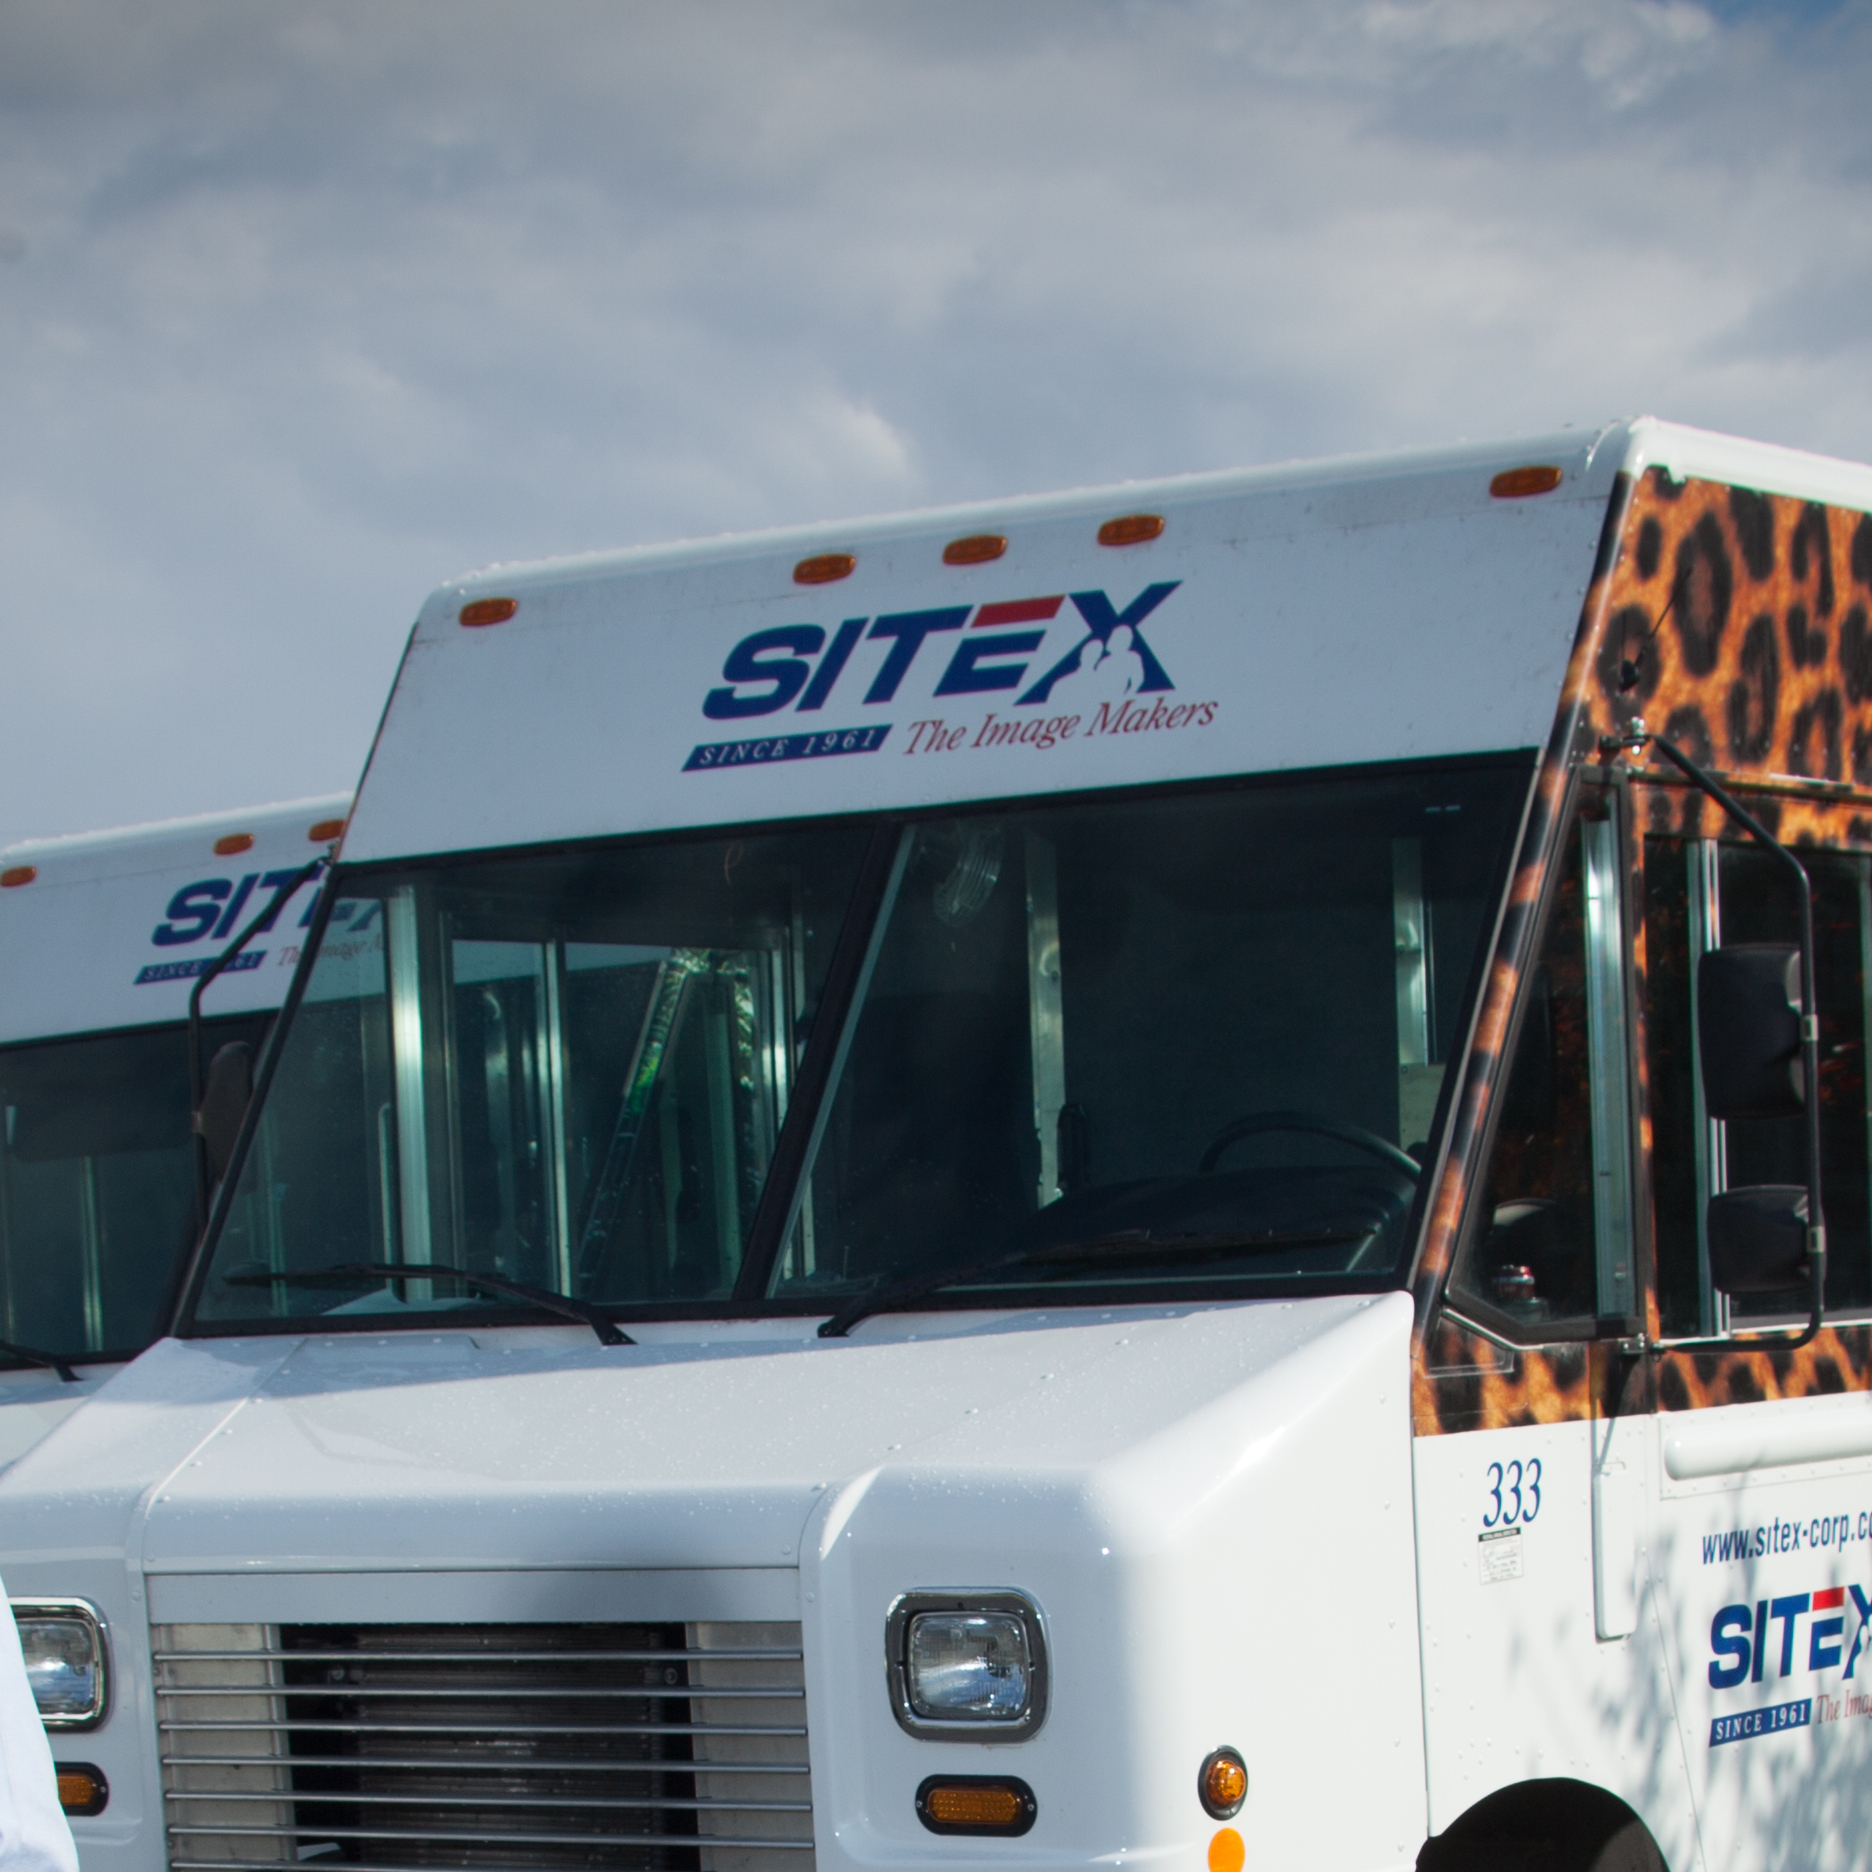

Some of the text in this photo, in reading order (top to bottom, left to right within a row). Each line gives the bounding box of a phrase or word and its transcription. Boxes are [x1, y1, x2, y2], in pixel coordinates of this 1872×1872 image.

[702, 580, 1184, 720] SITEX
[699, 697, 1219, 764] SINCE 1961 The Image Makers
[1482, 1457, 1543, 1528] 333
[1715, 1713, 1762, 1740] SINCE
[1770, 1703, 1807, 1729] 1961
[1817, 1694, 1841, 1725] The
